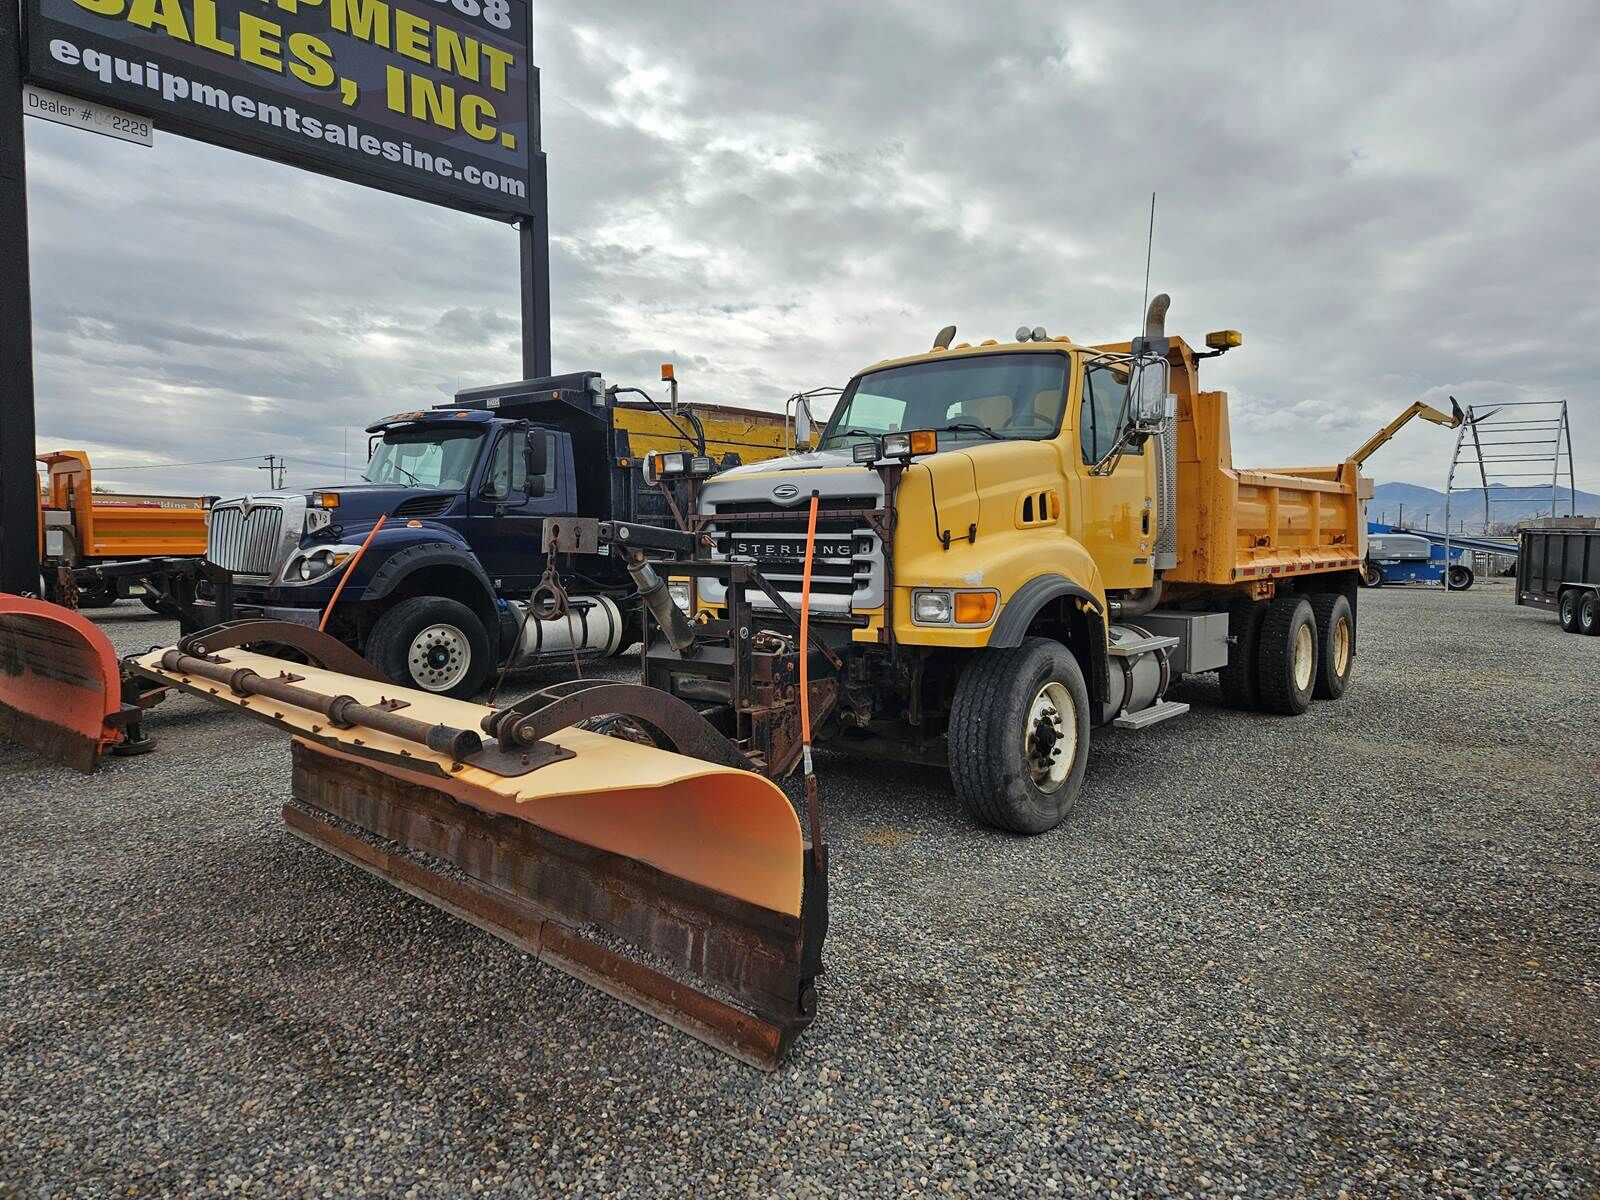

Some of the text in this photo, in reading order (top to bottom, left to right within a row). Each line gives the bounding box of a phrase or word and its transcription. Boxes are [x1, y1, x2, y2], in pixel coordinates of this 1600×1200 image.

[29, 93, 148, 137] Dealer # 2229
[49, 38, 525, 198] equipmentsalesinc.com
[387, 65, 515, 149] INC.
